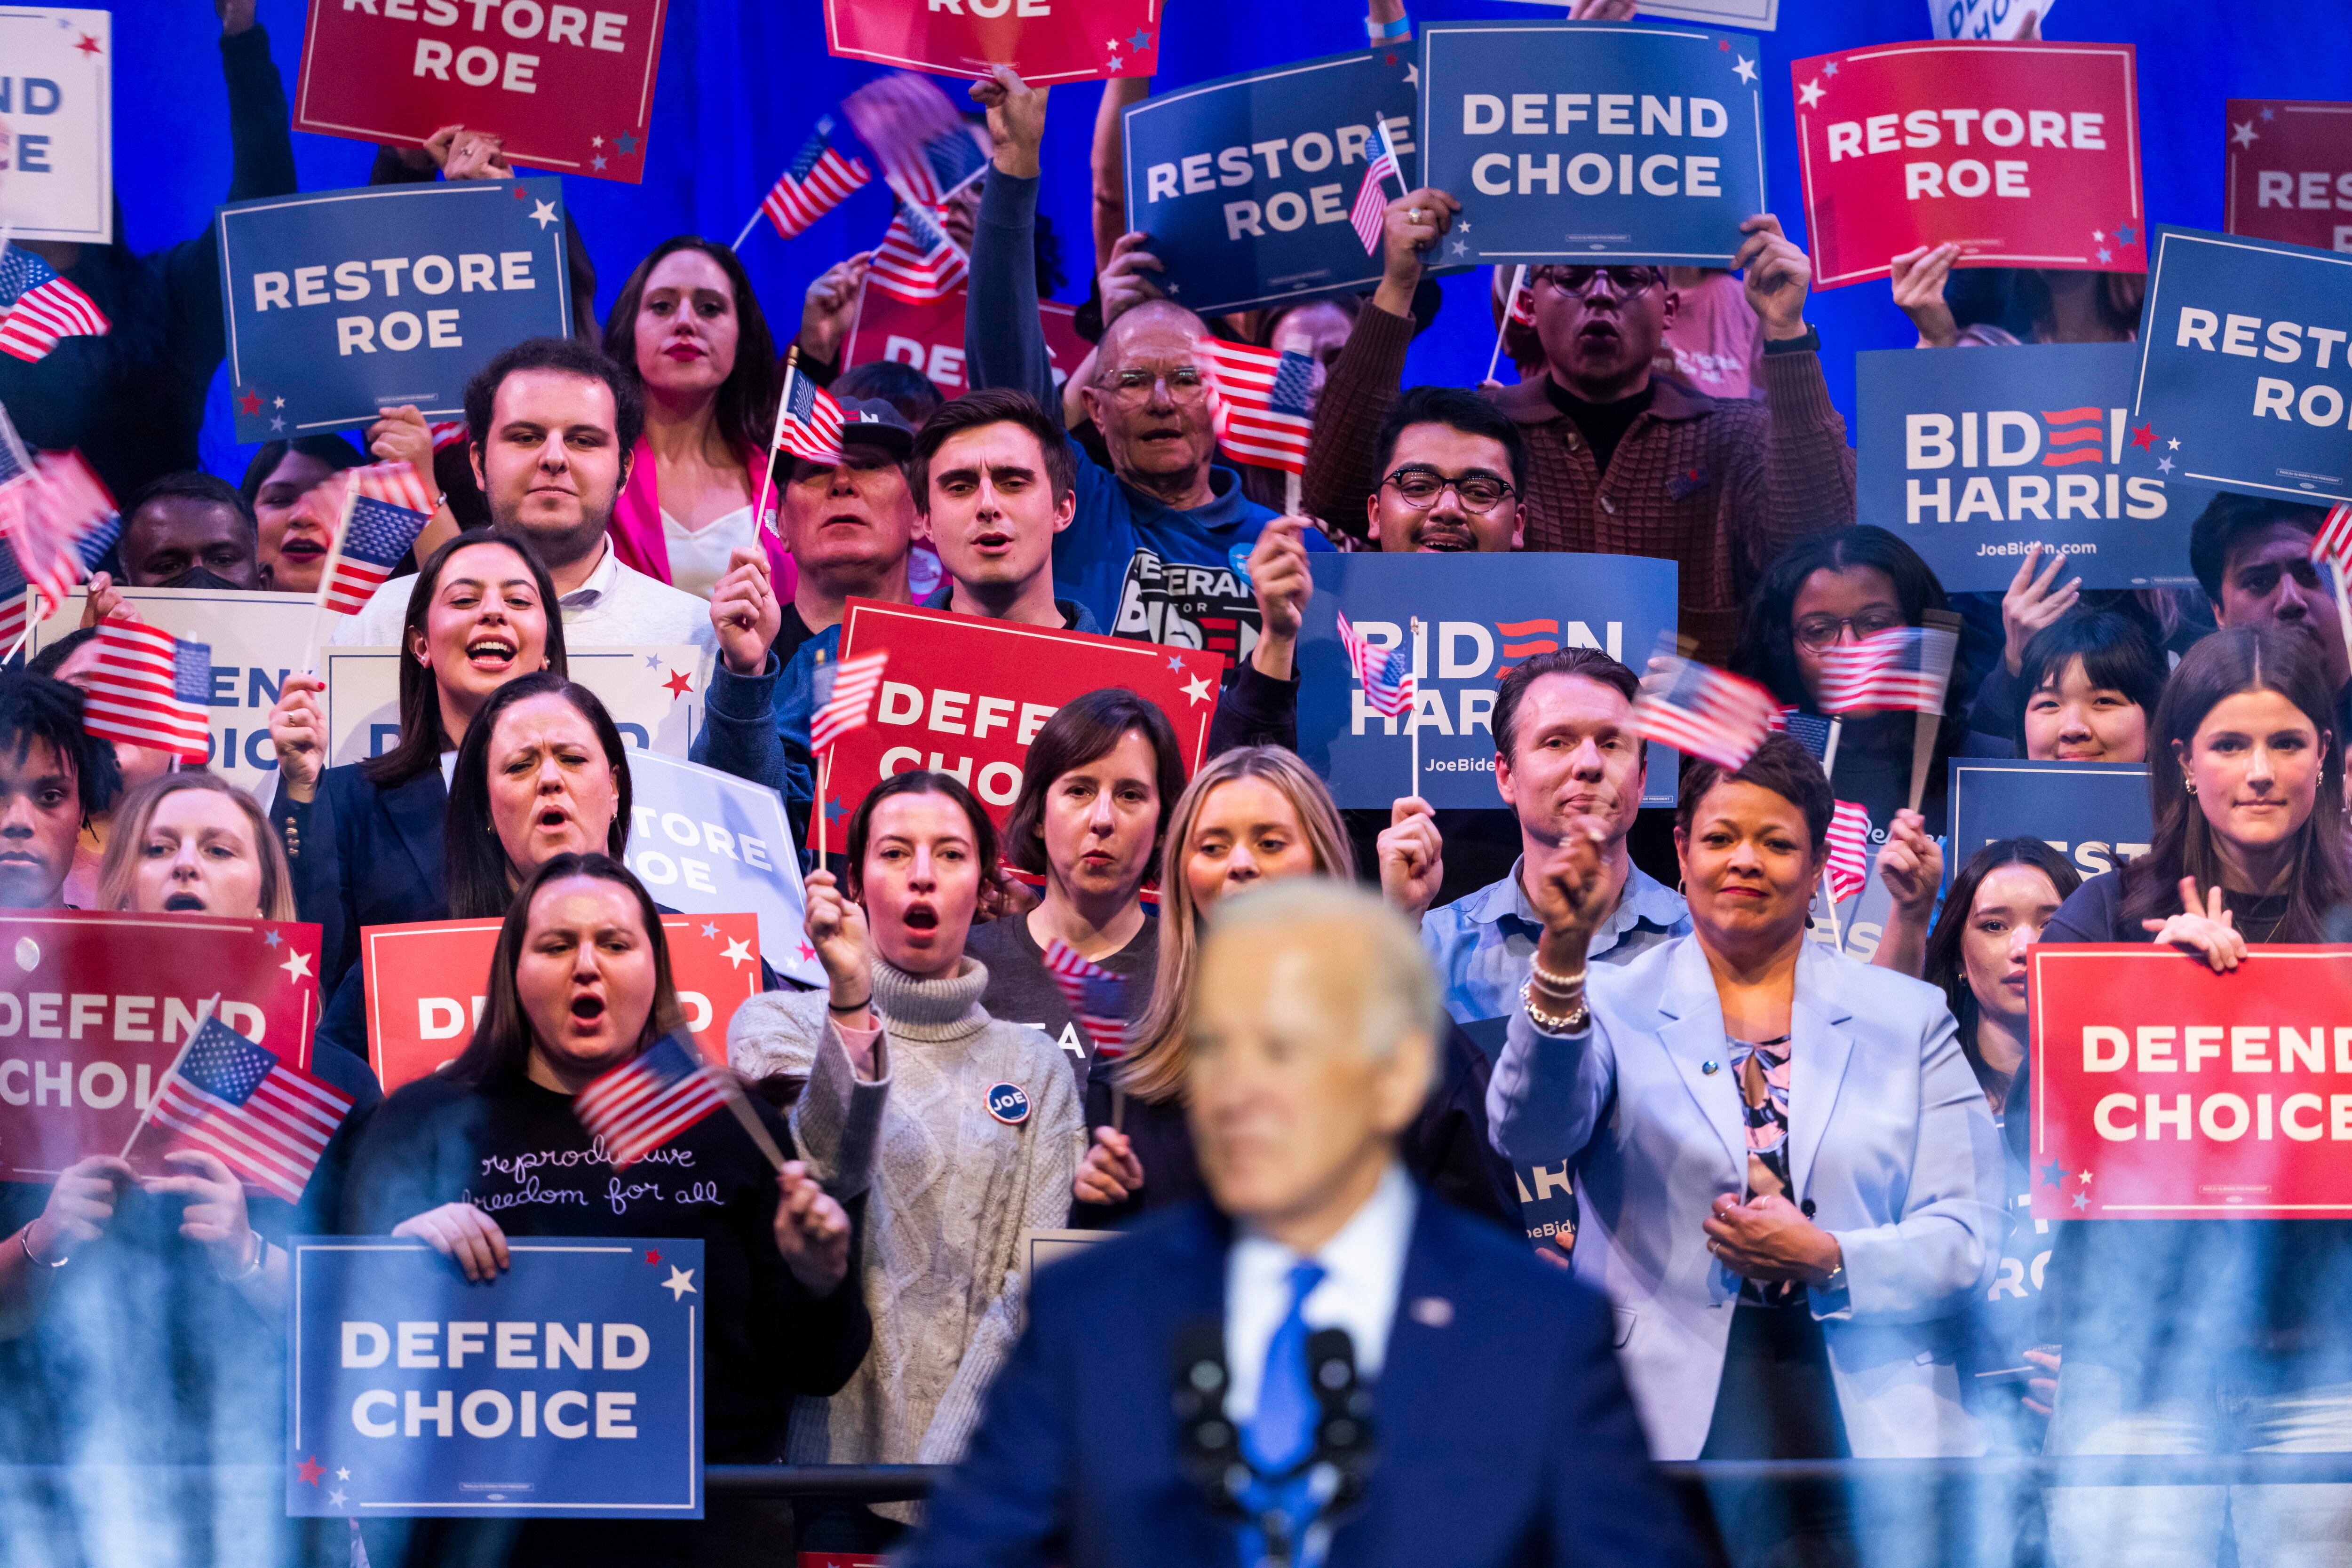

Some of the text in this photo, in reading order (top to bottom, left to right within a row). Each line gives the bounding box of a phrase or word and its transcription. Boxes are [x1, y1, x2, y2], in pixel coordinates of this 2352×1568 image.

[413, 39, 540, 94] ROE
[1463, 94, 1728, 138] DEFEND
[1827, 109, 2106, 162] RESTORE
[1147, 116, 1416, 203] RESTORE
[1472, 152, 1722, 197] CHOICE
[1905, 159, 2031, 200] ROE
[1224, 183, 1348, 240] ROE
[253, 251, 536, 311] RESTORE
[337, 309, 463, 356] ROE
[2177, 306, 2352, 369] REST
[2253, 376, 2352, 429] RO
[1906, 474, 2167, 524] HARRIS
[1976, 541, 2097, 556] JoeBidn.com
[1175, 602, 1208, 613] OR
[877, 681, 1059, 745] DEFE
[1351, 689, 1496, 735] HAR
[879, 746, 1024, 806] CHO
[1425, 758, 1496, 772] JoeBide
[631, 805, 772, 872] TORE
[624, 850, 717, 895] OE
[0, 1059, 151, 1109] CHOI
[994, 1092, 1026, 1111] JOE
[604, 1177, 664, 1215] for
[675, 1181, 725, 1205] all
[342, 1322, 650, 1370] DEFEND
[351, 1389, 637, 1439] CHOICE
